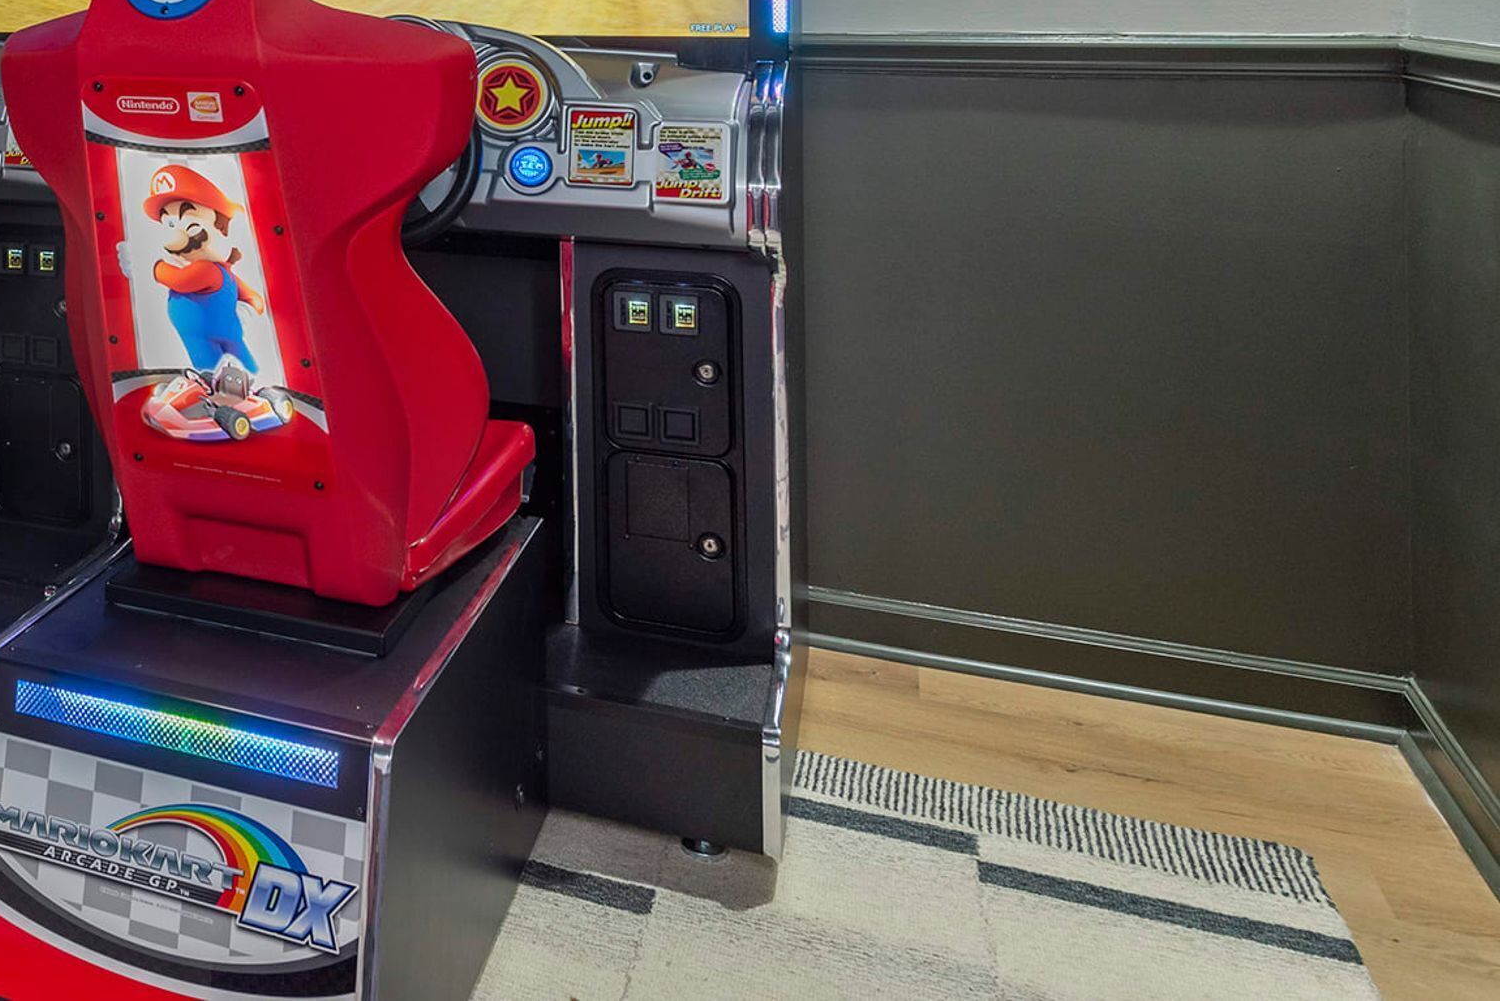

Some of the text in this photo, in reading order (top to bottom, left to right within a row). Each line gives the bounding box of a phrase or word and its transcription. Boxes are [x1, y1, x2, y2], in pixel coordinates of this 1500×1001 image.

[690, 23, 736, 32] FREE PLAY
[120, 98, 175, 111] Nintendo
[572, 113, 633, 129] Jump!!
[43, 844, 135, 881] ARCADE
[149, 873, 179, 892] GP
[238, 862, 358, 951] DX
